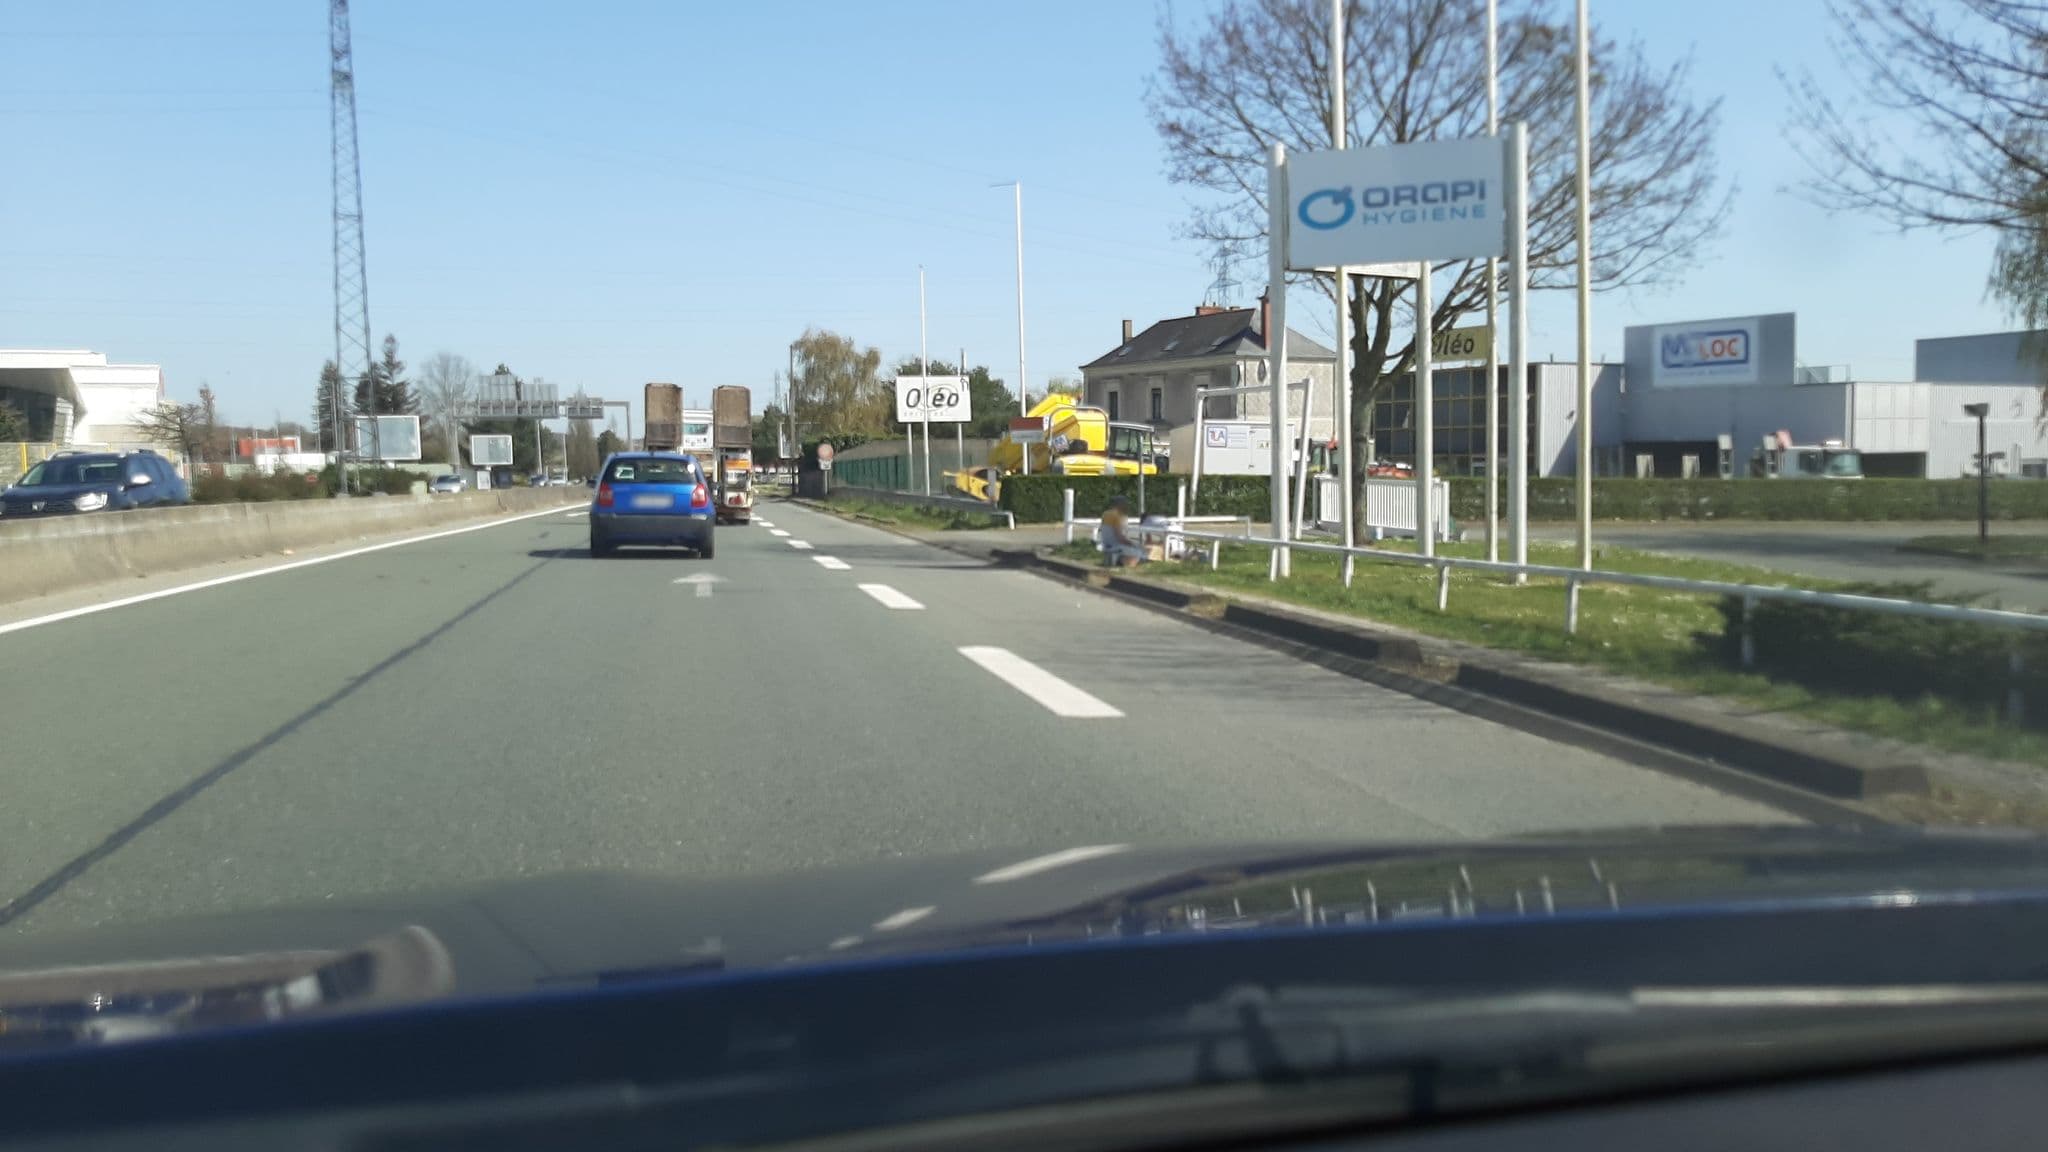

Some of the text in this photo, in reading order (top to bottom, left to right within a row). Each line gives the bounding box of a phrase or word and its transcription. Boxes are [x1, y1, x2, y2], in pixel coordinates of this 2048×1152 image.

[1362, 179, 1487, 208] ORAPI
[1362, 204, 1487, 225] HYGIENE
[906, 387, 959, 409] Oléo
